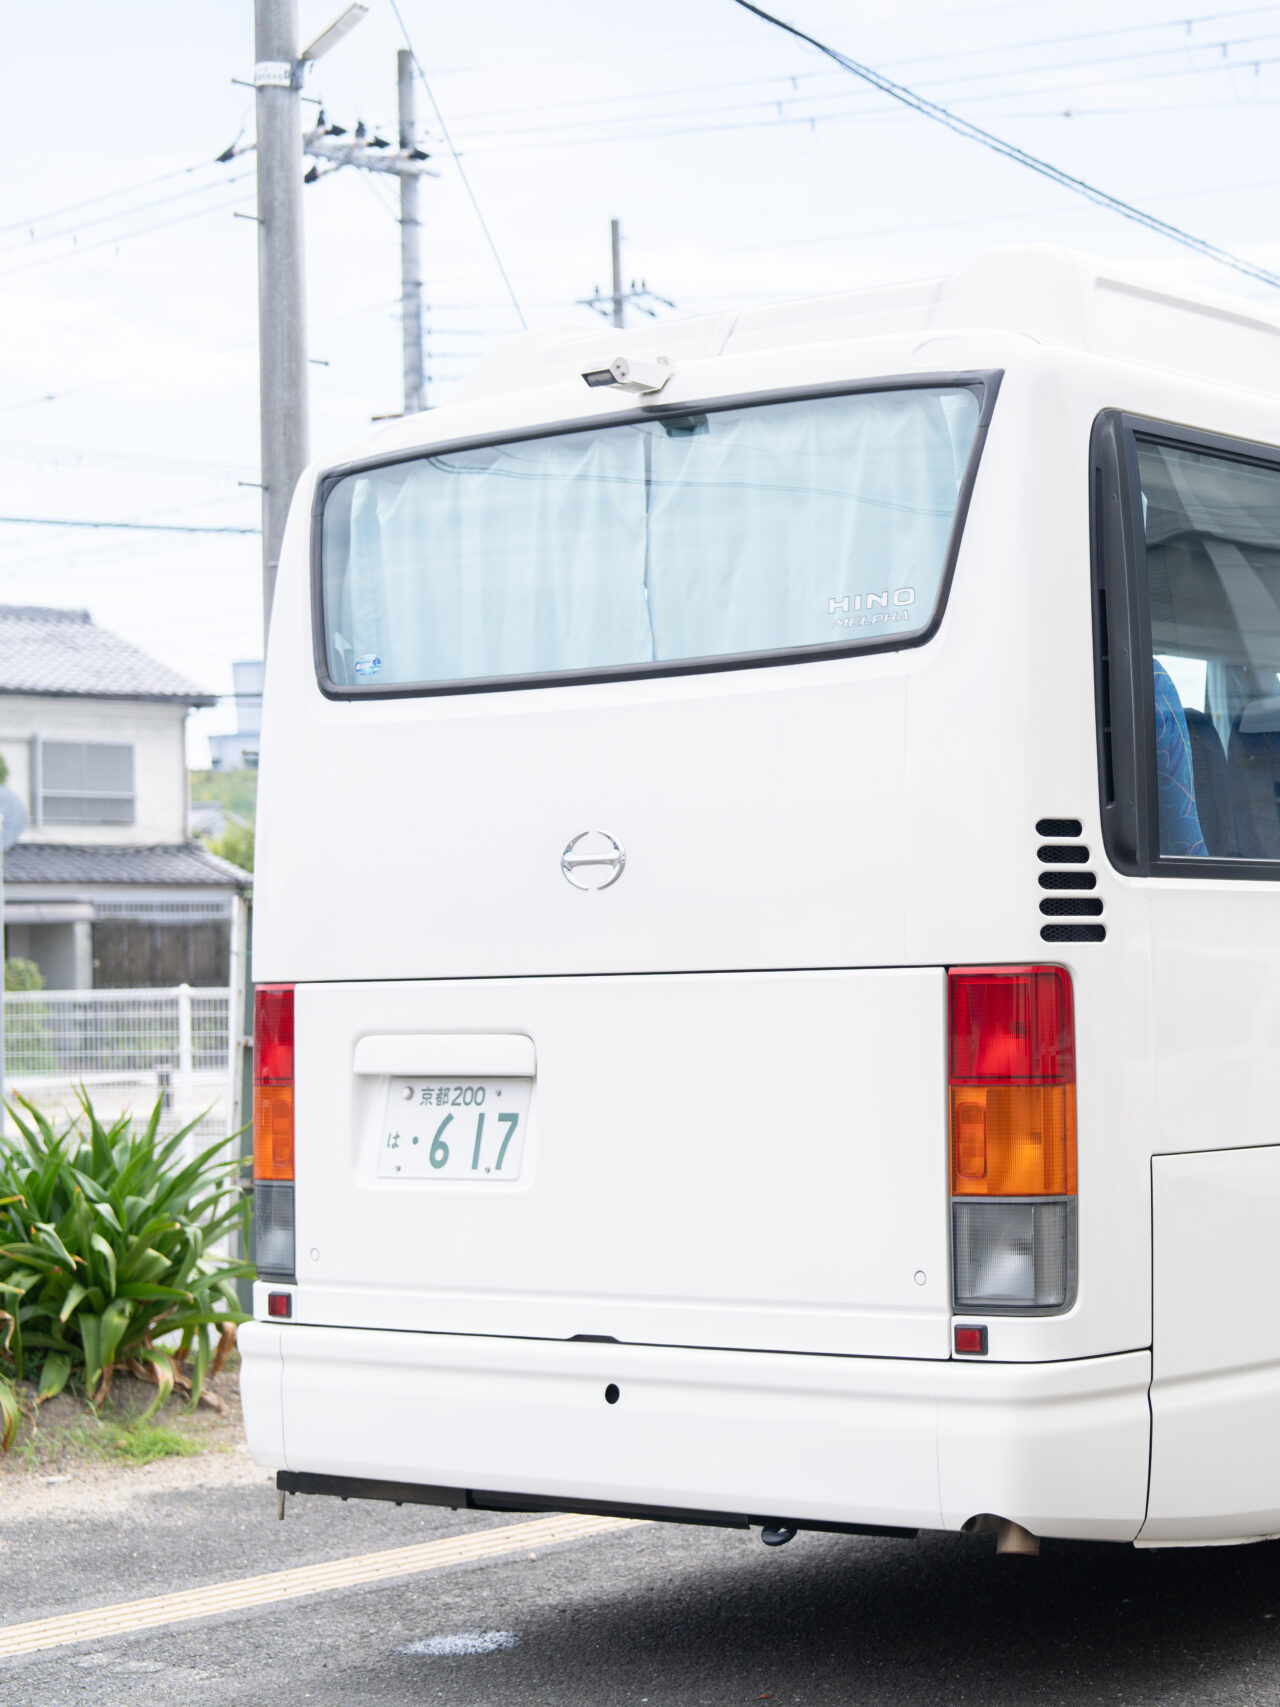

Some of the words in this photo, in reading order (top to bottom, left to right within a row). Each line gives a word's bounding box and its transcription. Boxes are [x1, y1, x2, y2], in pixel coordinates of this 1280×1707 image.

[827, 586, 916, 615] HINO
[831, 609, 910, 630] MELPHA
[419, 1086, 486, 1107] 京都200
[387, 1131, 401, 1149] は
